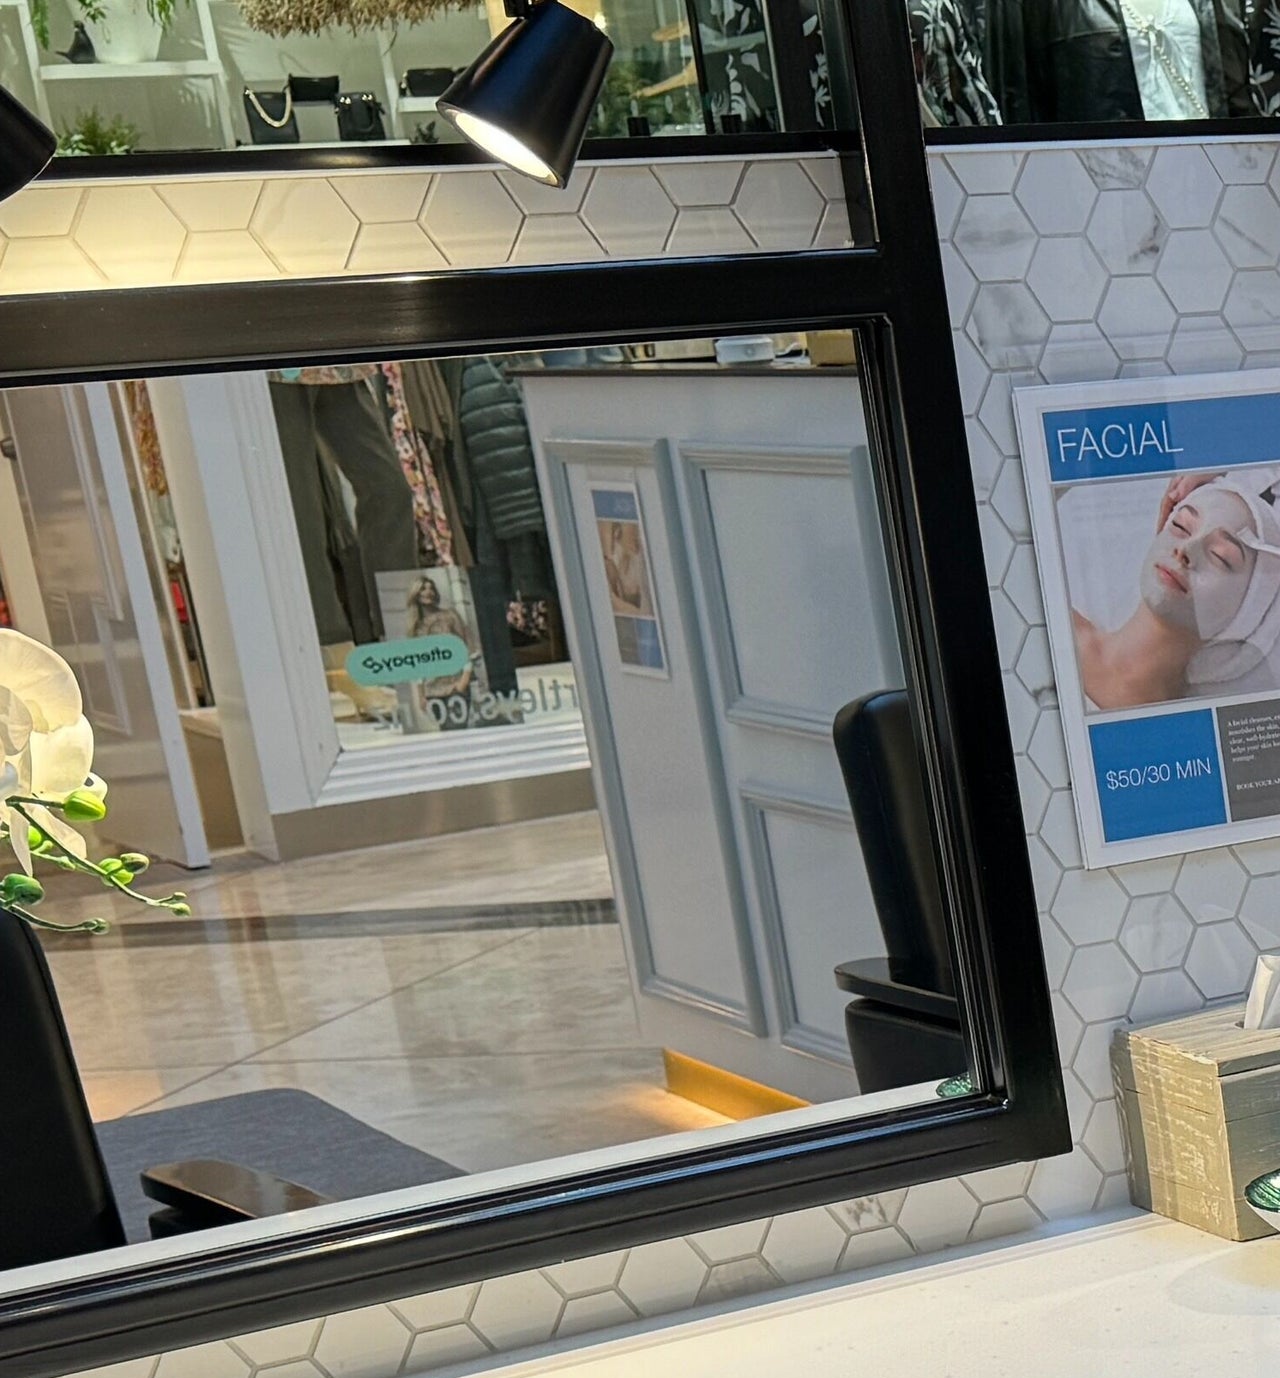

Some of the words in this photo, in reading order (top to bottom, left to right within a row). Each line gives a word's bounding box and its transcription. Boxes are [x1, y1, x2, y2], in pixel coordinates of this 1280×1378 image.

[1057, 420, 1184, 462] FACIAL
[1106, 763, 1171, 790] $50/30
[1176, 757, 1212, 780] MIN
